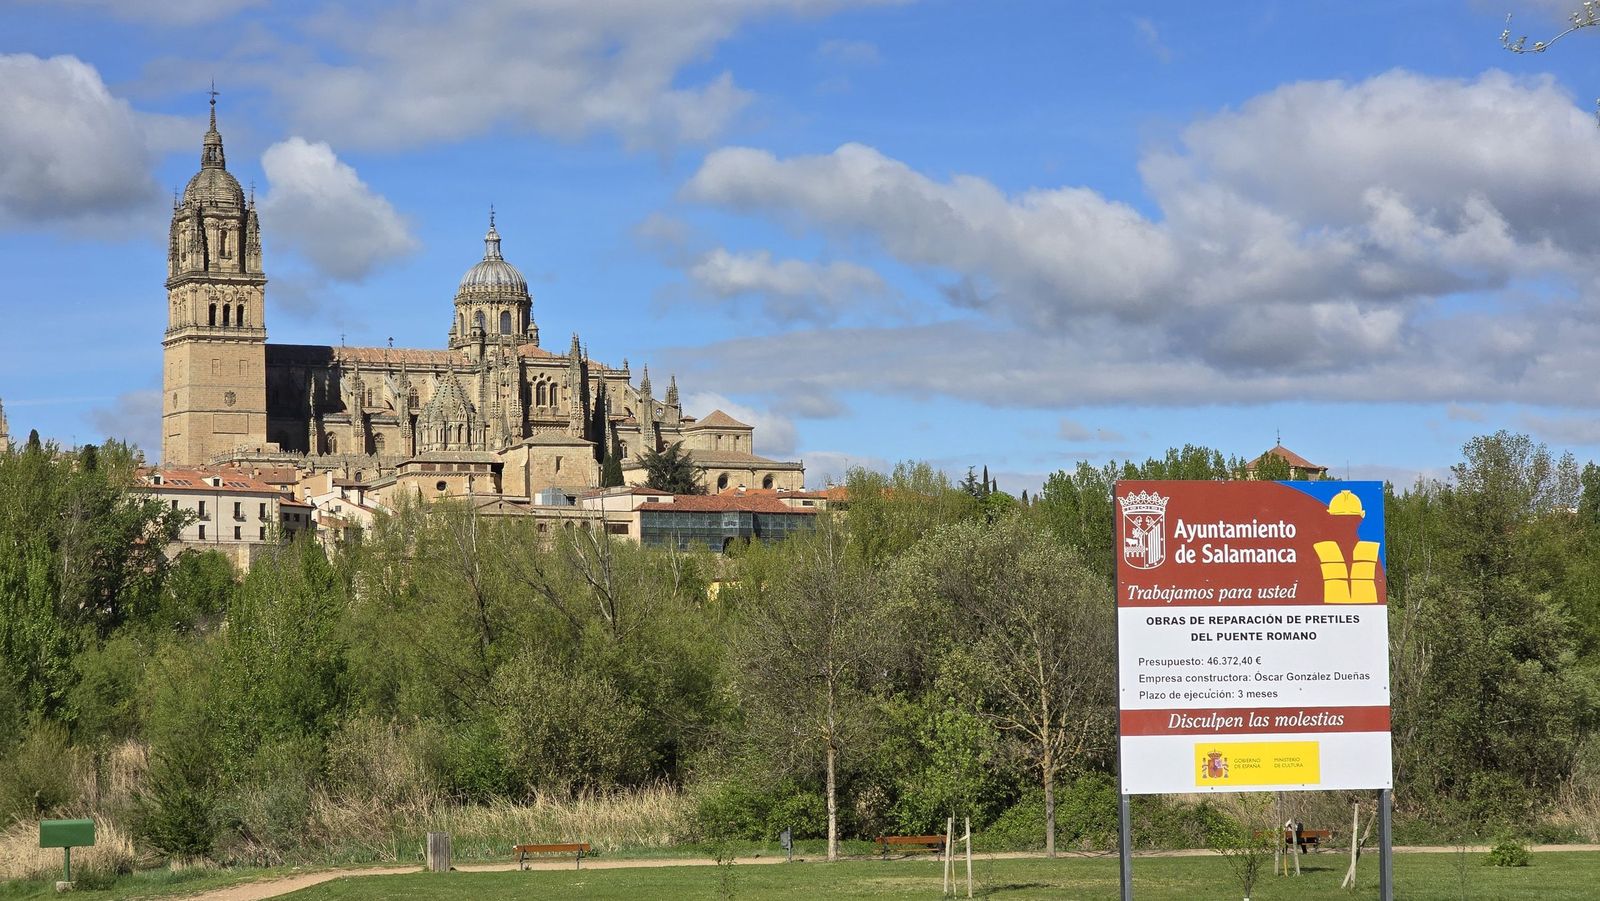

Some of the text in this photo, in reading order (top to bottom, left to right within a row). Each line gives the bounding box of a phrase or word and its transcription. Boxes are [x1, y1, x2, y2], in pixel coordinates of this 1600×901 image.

[1174, 519, 1296, 543] Ayuntamiento
[1175, 543, 1297, 564] de Salamanca
[1127, 584, 1298, 604] Trabajamos para usted
[1146, 613, 1360, 626] OBRAS DE REPARACIÓN DE PRETILES
[1191, 631, 1317, 641] DEL PUENTE ROMANO
[1138, 656, 1262, 668] Presupuesto: 46.372,40 €
[1139, 671, 1370, 685] Empresa constructora: Óscar González Dueñas
[1139, 689, 1278, 701] Plazo de ejecución: 3 meses
[1168, 711, 1344, 731] Disculpen las molestias
